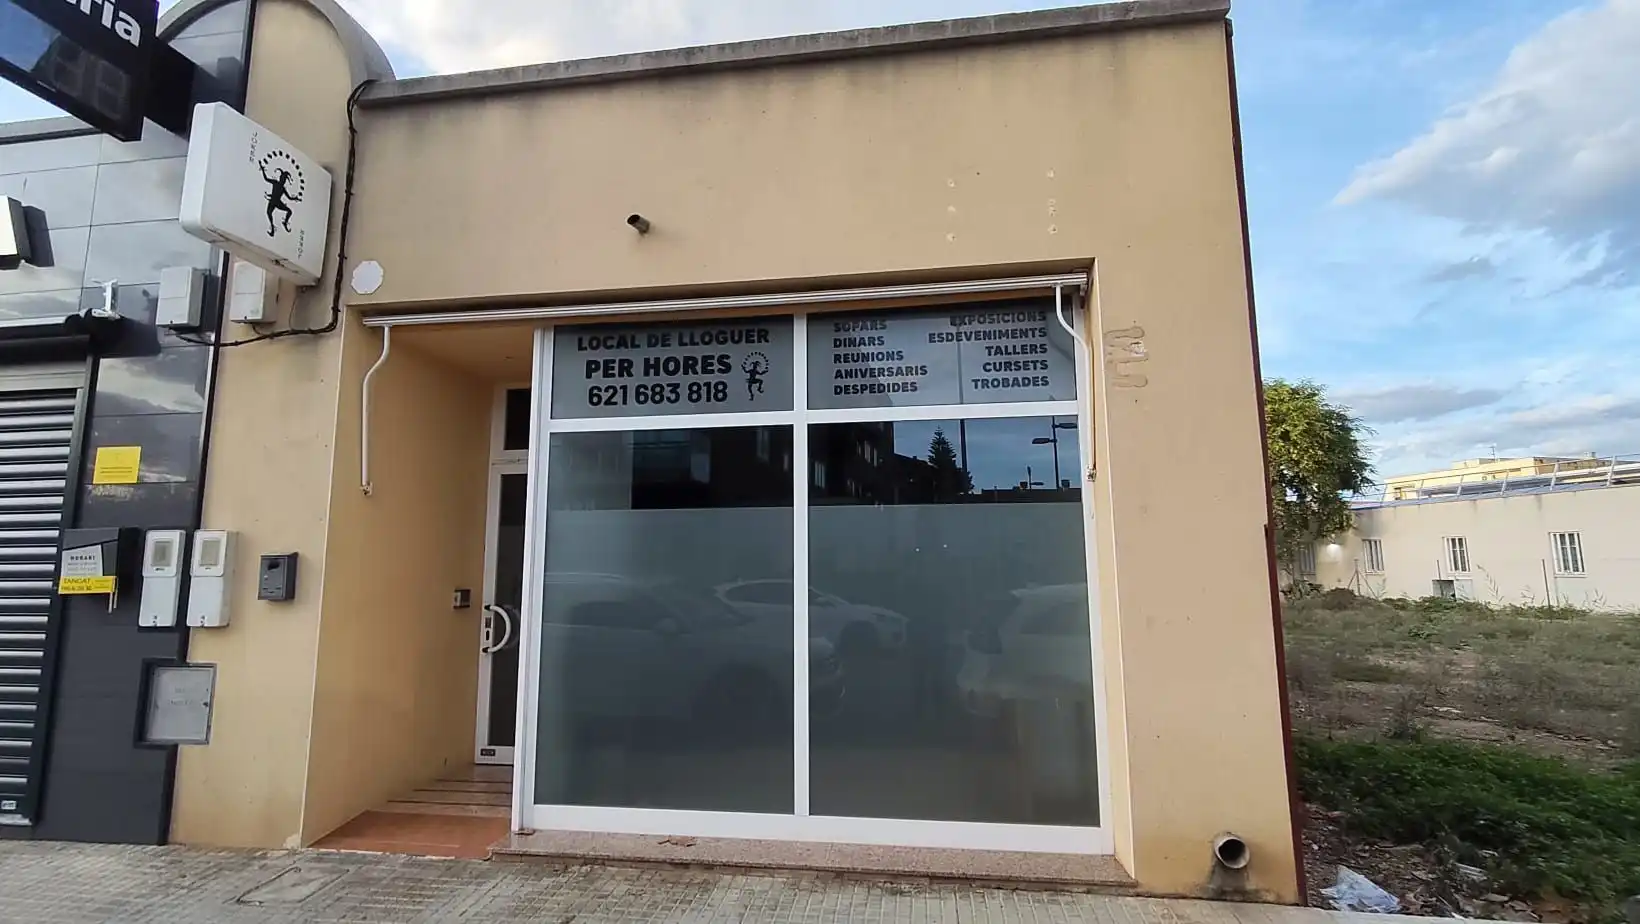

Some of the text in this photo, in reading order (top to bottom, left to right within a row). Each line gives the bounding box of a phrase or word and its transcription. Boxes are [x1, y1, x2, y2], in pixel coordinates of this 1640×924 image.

[65, 0, 141, 48] ria
[950, 311, 1047, 327] EXPOSICIONS
[577, 328, 770, 352] LOCAL DE LLOGUER
[833, 335, 885, 349] DINARS
[928, 327, 1048, 344] ESDEVENIMENTS
[833, 350, 904, 364] REUNIONS
[985, 343, 1048, 357] TALLERS
[585, 354, 733, 379] PER HORES
[834, 365, 928, 380] ANIVERSARIS
[982, 359, 1049, 373] CURSETS
[834, 381, 918, 396] DESPEDIDES
[971, 376, 1050, 390] TROBADES
[588, 380, 728, 407] 621 683 818
